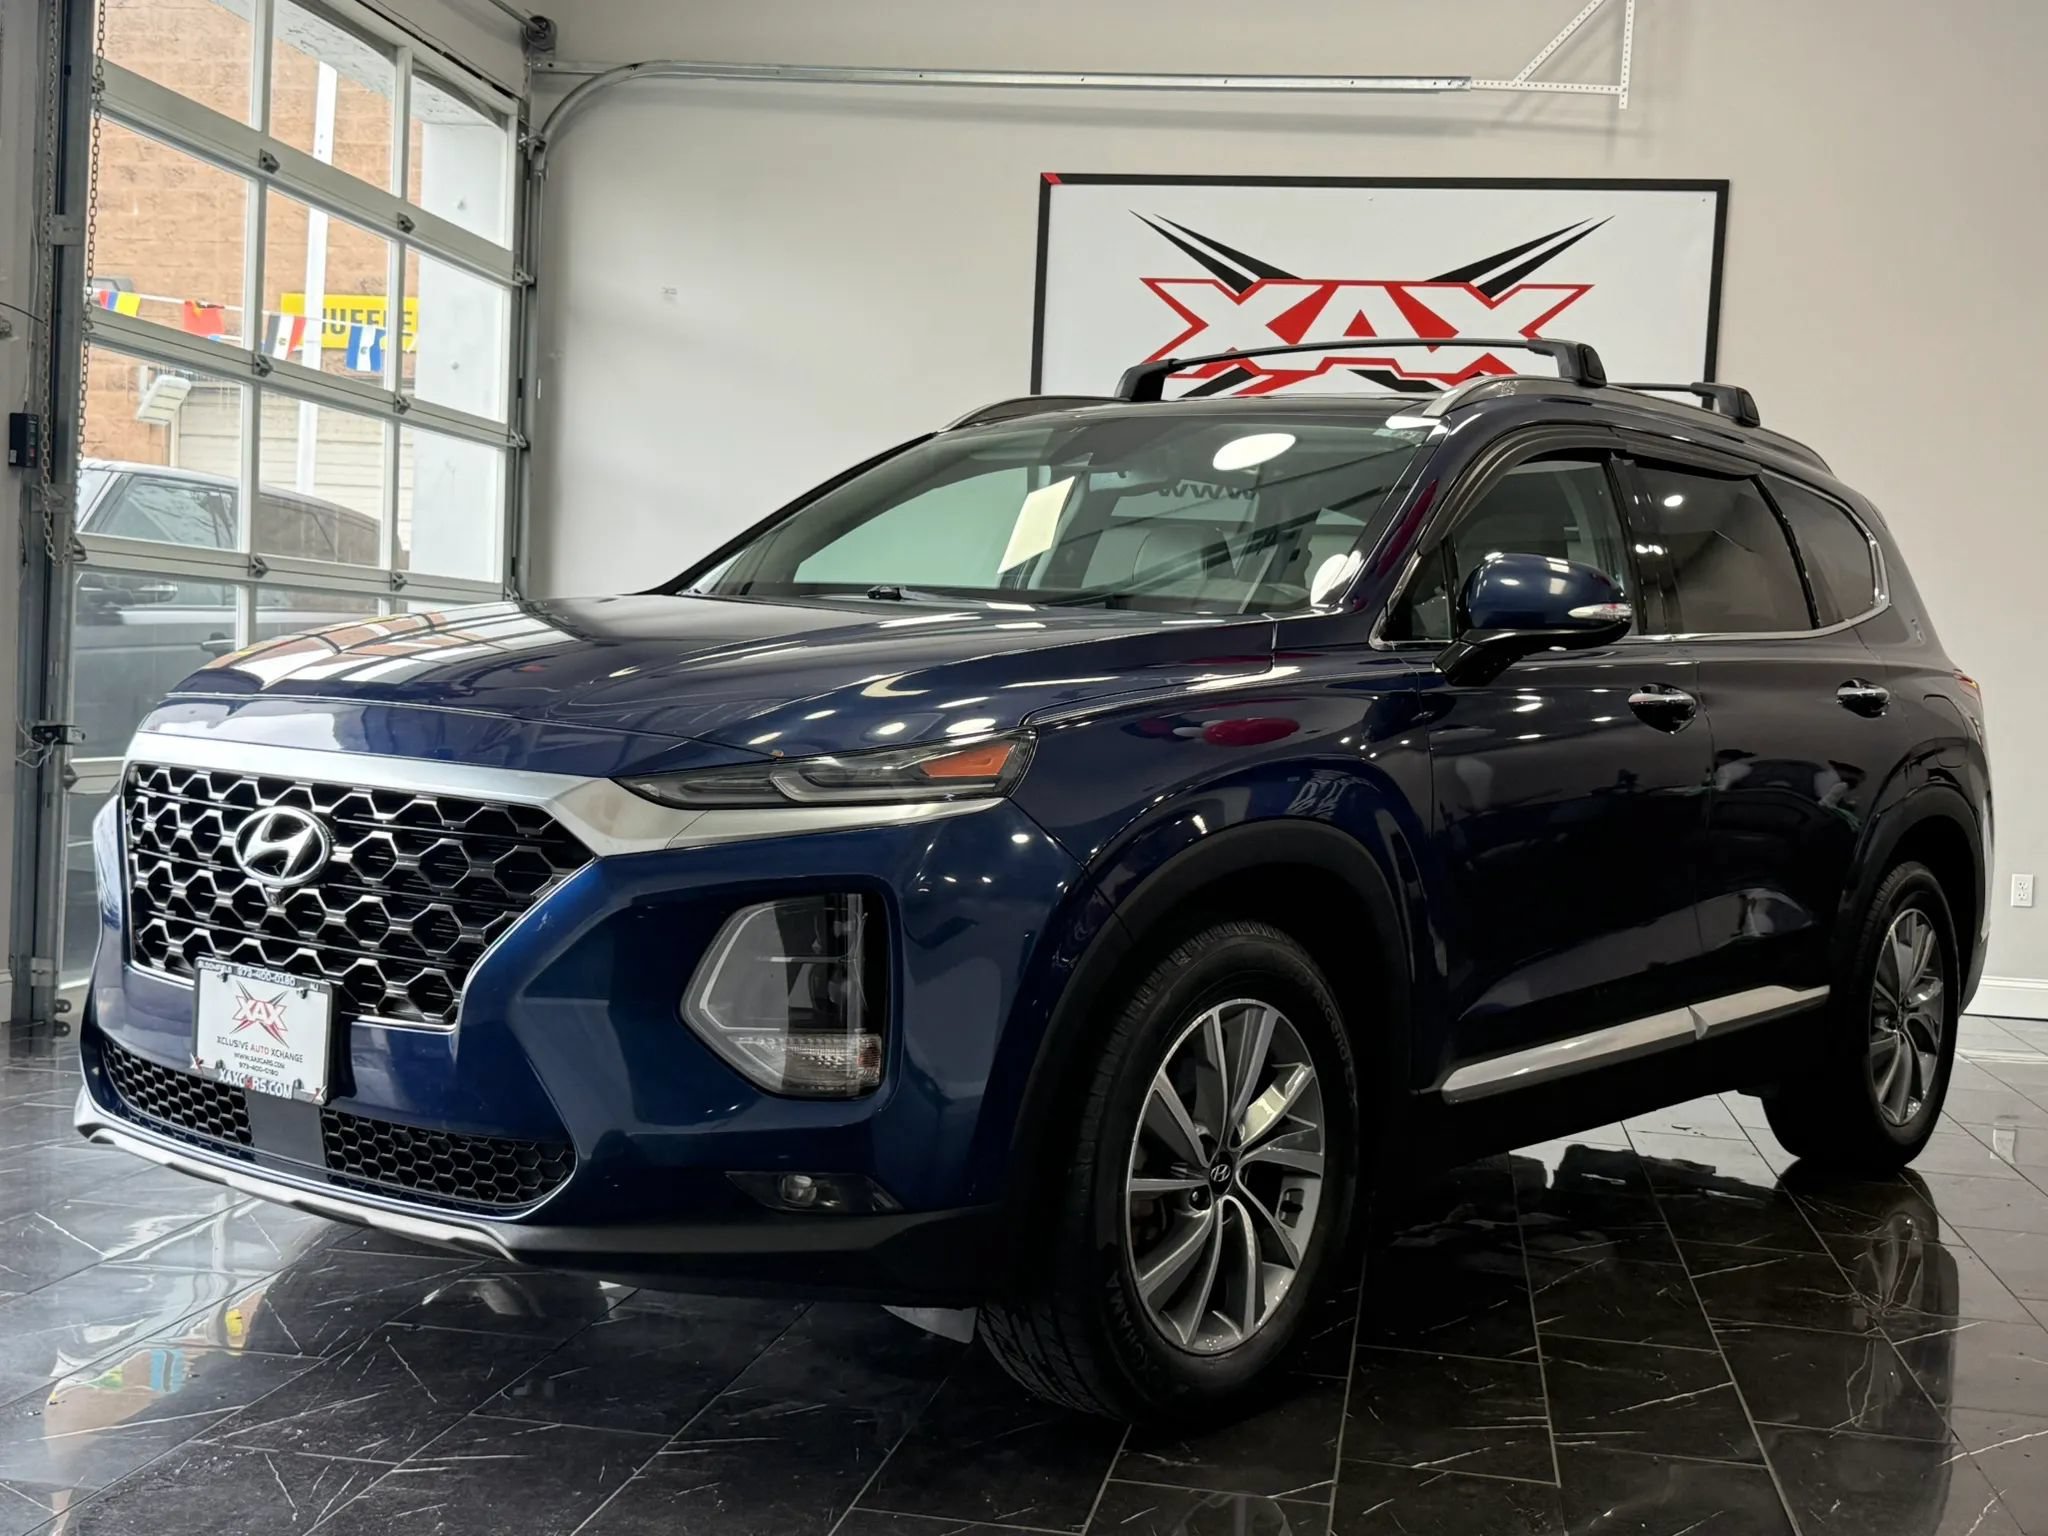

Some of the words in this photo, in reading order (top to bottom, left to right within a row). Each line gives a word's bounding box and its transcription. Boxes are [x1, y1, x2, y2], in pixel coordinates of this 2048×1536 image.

[322, 308, 412, 336] UFFE
[1139, 277, 1596, 388] XAX
[232, 995, 288, 1032] XAX
[216, 1035, 249, 1051] XCLUSIVE
[250, 1043, 270, 1055] AUTO
[271, 1047, 304, 1063] XCHANGE
[218, 1068, 294, 1100] XAXCARS.COM
